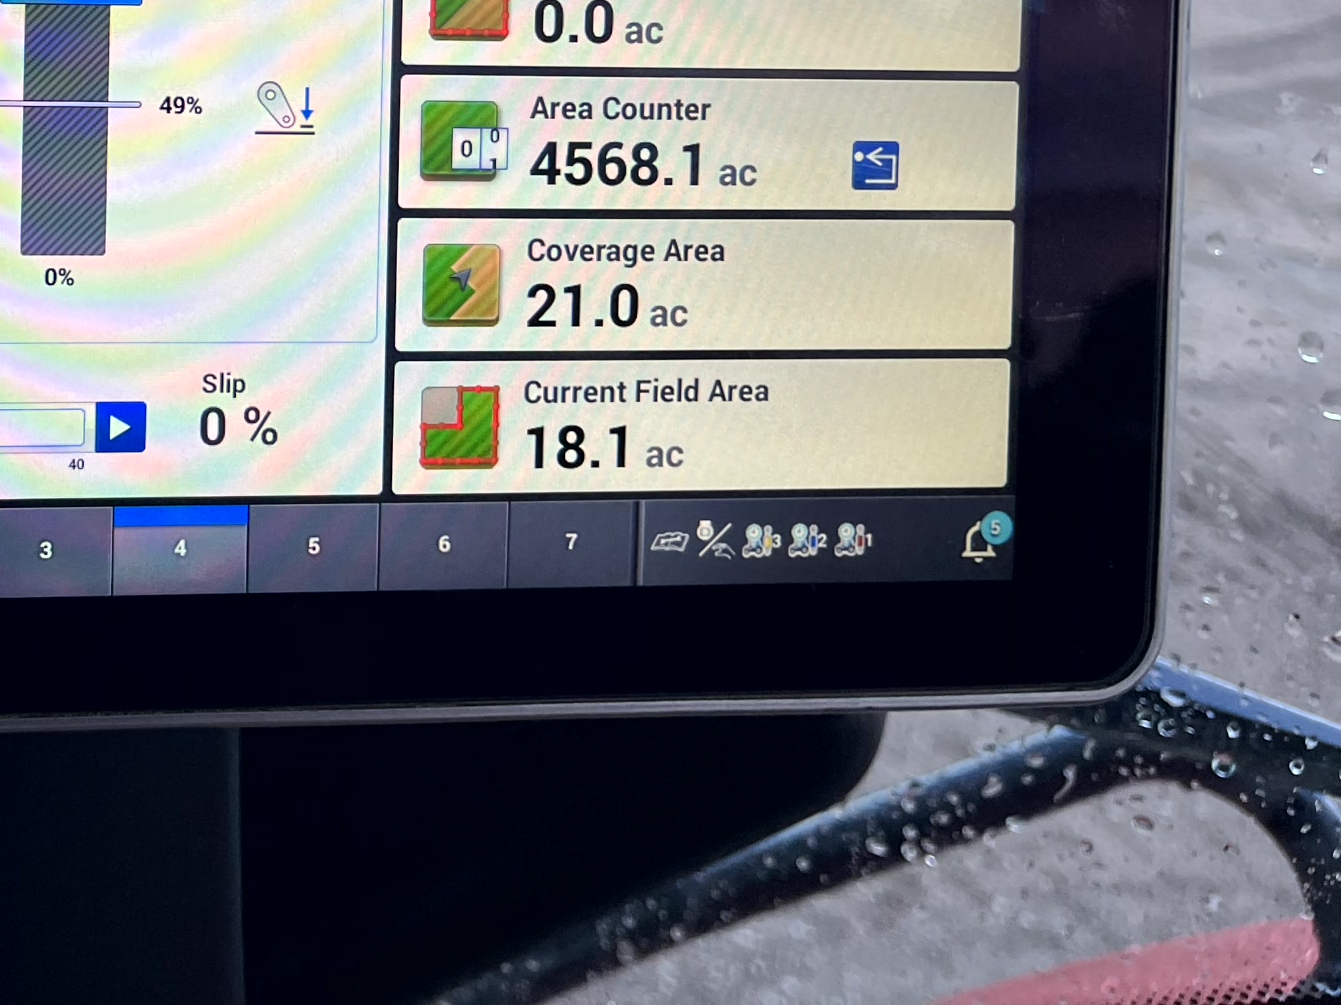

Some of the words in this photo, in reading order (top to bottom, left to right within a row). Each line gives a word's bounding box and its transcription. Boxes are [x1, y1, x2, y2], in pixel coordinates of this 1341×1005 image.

[625, 20, 664, 44] ac
[159, 96, 203, 115] 49%
[530, 96, 593, 120] Area
[602, 96, 712, 122] Counter
[461, 140, 472, 157] 0
[530, 141, 702, 187] 4568.1
[719, 164, 758, 187] ac
[527, 239, 656, 268] Coverage
[663, 239, 726, 263] Area
[44, 268, 75, 286] 0%
[526, 283, 639, 328] 21.0
[649, 305, 689, 327] ac
[202, 373, 246, 397] Slip
[524, 381, 627, 404] Current
[635, 379, 700, 403] Field
[708, 380, 770, 402] Area
[198, 406, 227, 447] 0
[243, 407, 279, 447] %
[526, 425, 628, 469] 18.1
[645, 445, 684, 467] ac
[68, 458, 85, 470] 40
[989, 520, 1001, 535] 5
[173, 540, 187, 557] 4
[308, 537, 320, 554] 5
[438, 535, 451, 552] 6
[565, 533, 578, 550] 7
[772, 535, 781, 547] 3
[818, 534, 827, 547] 2
[866, 534, 872, 546] 1
[39, 542, 53, 559] 3
